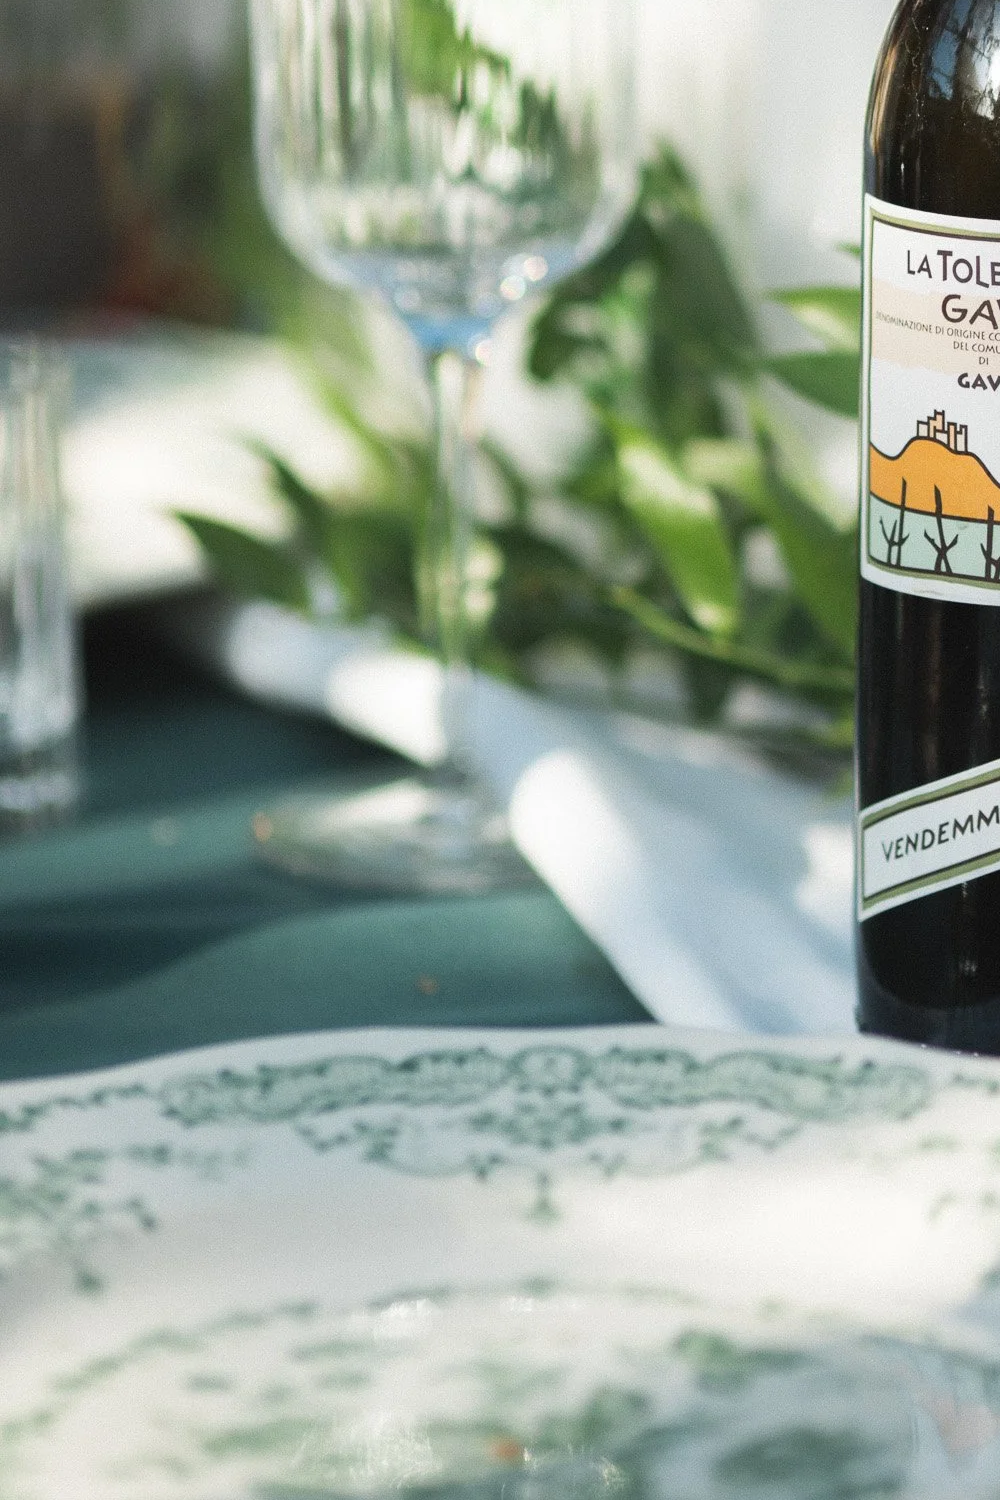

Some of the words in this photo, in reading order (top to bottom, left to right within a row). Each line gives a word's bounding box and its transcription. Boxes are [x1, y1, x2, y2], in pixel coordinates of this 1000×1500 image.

[907, 250, 932, 279] LA
[935, 326, 945, 336] DI
[946, 327, 986, 341] ORIGINE
[953, 340, 969, 351] DEL
[978, 356, 989, 366] DI
